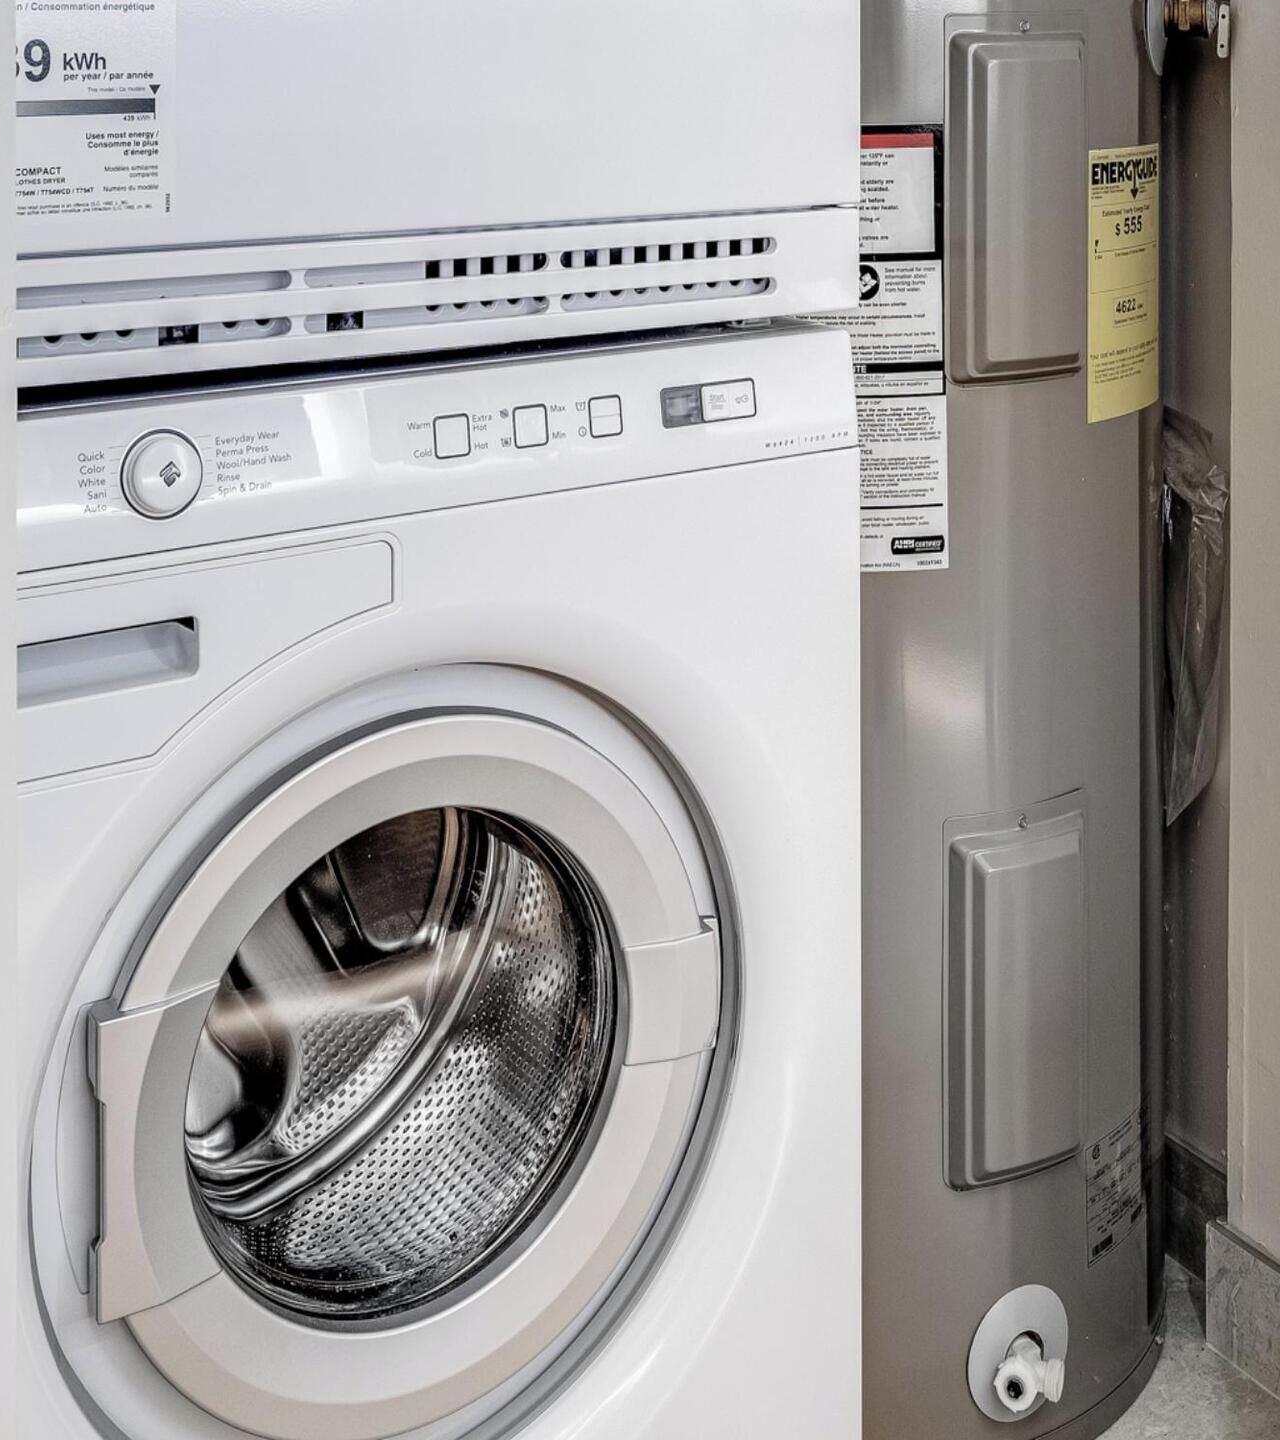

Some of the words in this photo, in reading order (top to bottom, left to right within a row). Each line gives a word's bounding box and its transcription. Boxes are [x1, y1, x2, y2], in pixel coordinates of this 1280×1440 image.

[30, 1, 101, 11] Consommation
[102, 2, 156, 13] énergétique
[62, 52, 107, 71] kWh
[63, 72, 79, 82] per
[81, 72, 102, 82] year
[109, 71, 124, 81] par
[126, 70, 154, 80] année
[85, 131, 105, 140] Uses
[106, 131, 127, 140] most
[128, 131, 155, 140] energy
[87, 140, 132, 149] Consomme
[133, 139, 141, 147] le
[142, 139, 159, 148] plus
[42, 176, 66, 185] DRYER
[1123, 214, 1143, 235] 555
[1115, 297, 1137, 314] 4622
[549, 403, 566, 413] Max
[471, 413, 493, 423] Extra
[406, 421, 431, 431] Warm
[472, 423, 488, 432] Hot
[214, 433, 256, 446] Everyday
[256, 431, 280, 440] Wear
[551, 431, 567, 440] Min
[215, 447, 244, 458] Perma
[245, 444, 270, 454] Press
[473, 441, 489, 451] Hot
[77, 450, 105, 462] Quick
[412, 447, 433, 459] Cold
[215, 455, 267, 470] Wool/Hand
[268, 452, 293, 464] Wash
[79, 463, 106, 475] Color
[77, 477, 106, 489] White
[216, 472, 241, 483] Rinse
[217, 485, 238, 497] Spin
[239, 482, 246, 493] &
[248, 479, 273, 492] Drain
[87, 488, 107, 501] Sani
[83, 503, 108, 513] Auto
